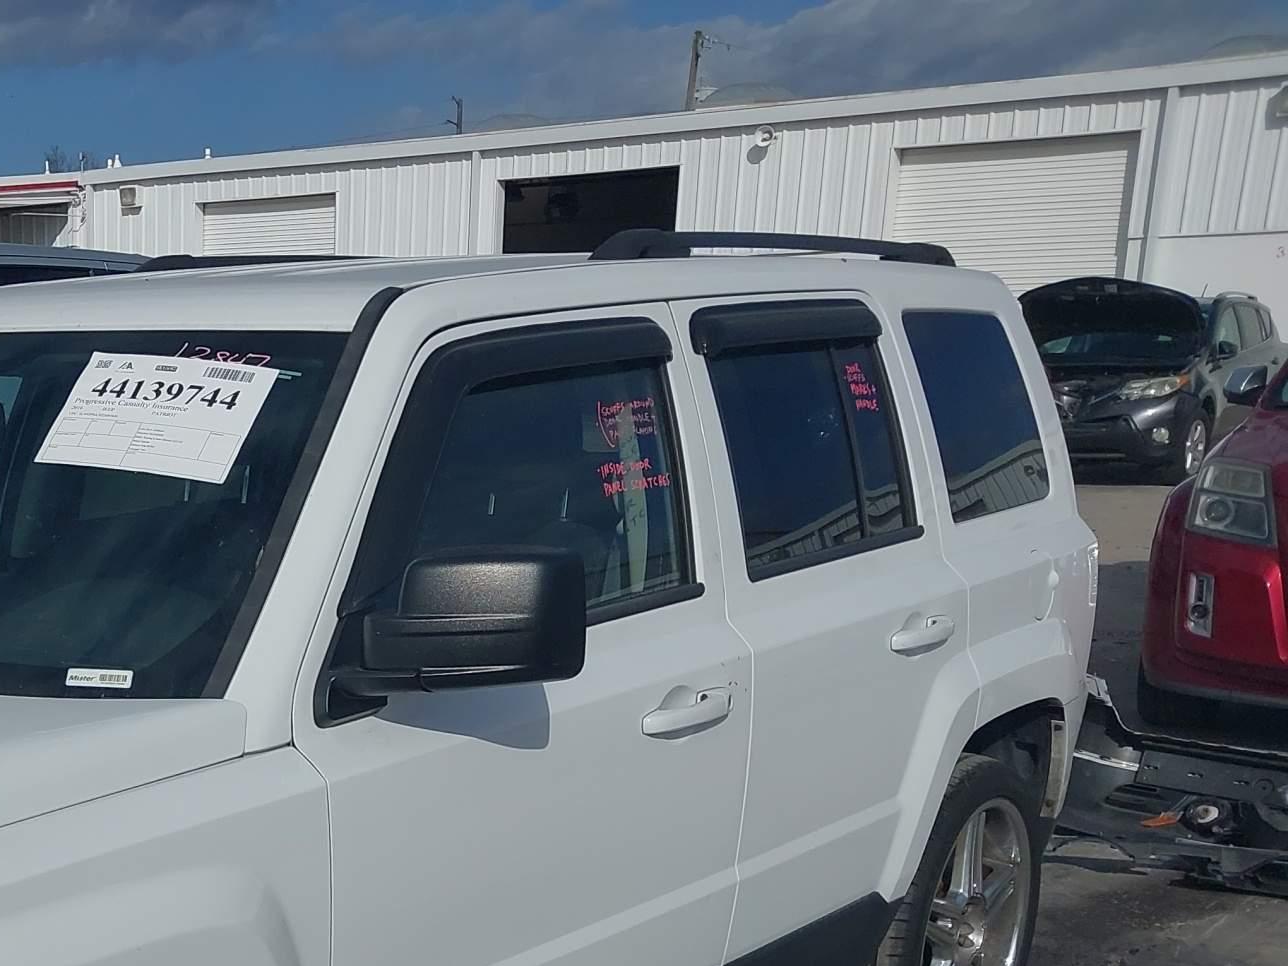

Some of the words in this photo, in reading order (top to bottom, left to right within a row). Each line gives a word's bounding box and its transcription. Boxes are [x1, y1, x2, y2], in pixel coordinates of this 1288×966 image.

[74, 397, 116, 406] Progressive
[118, 399, 151, 409] Casualty
[152, 402, 189, 412] Insurance
[92, 377, 241, 411] 44139744
